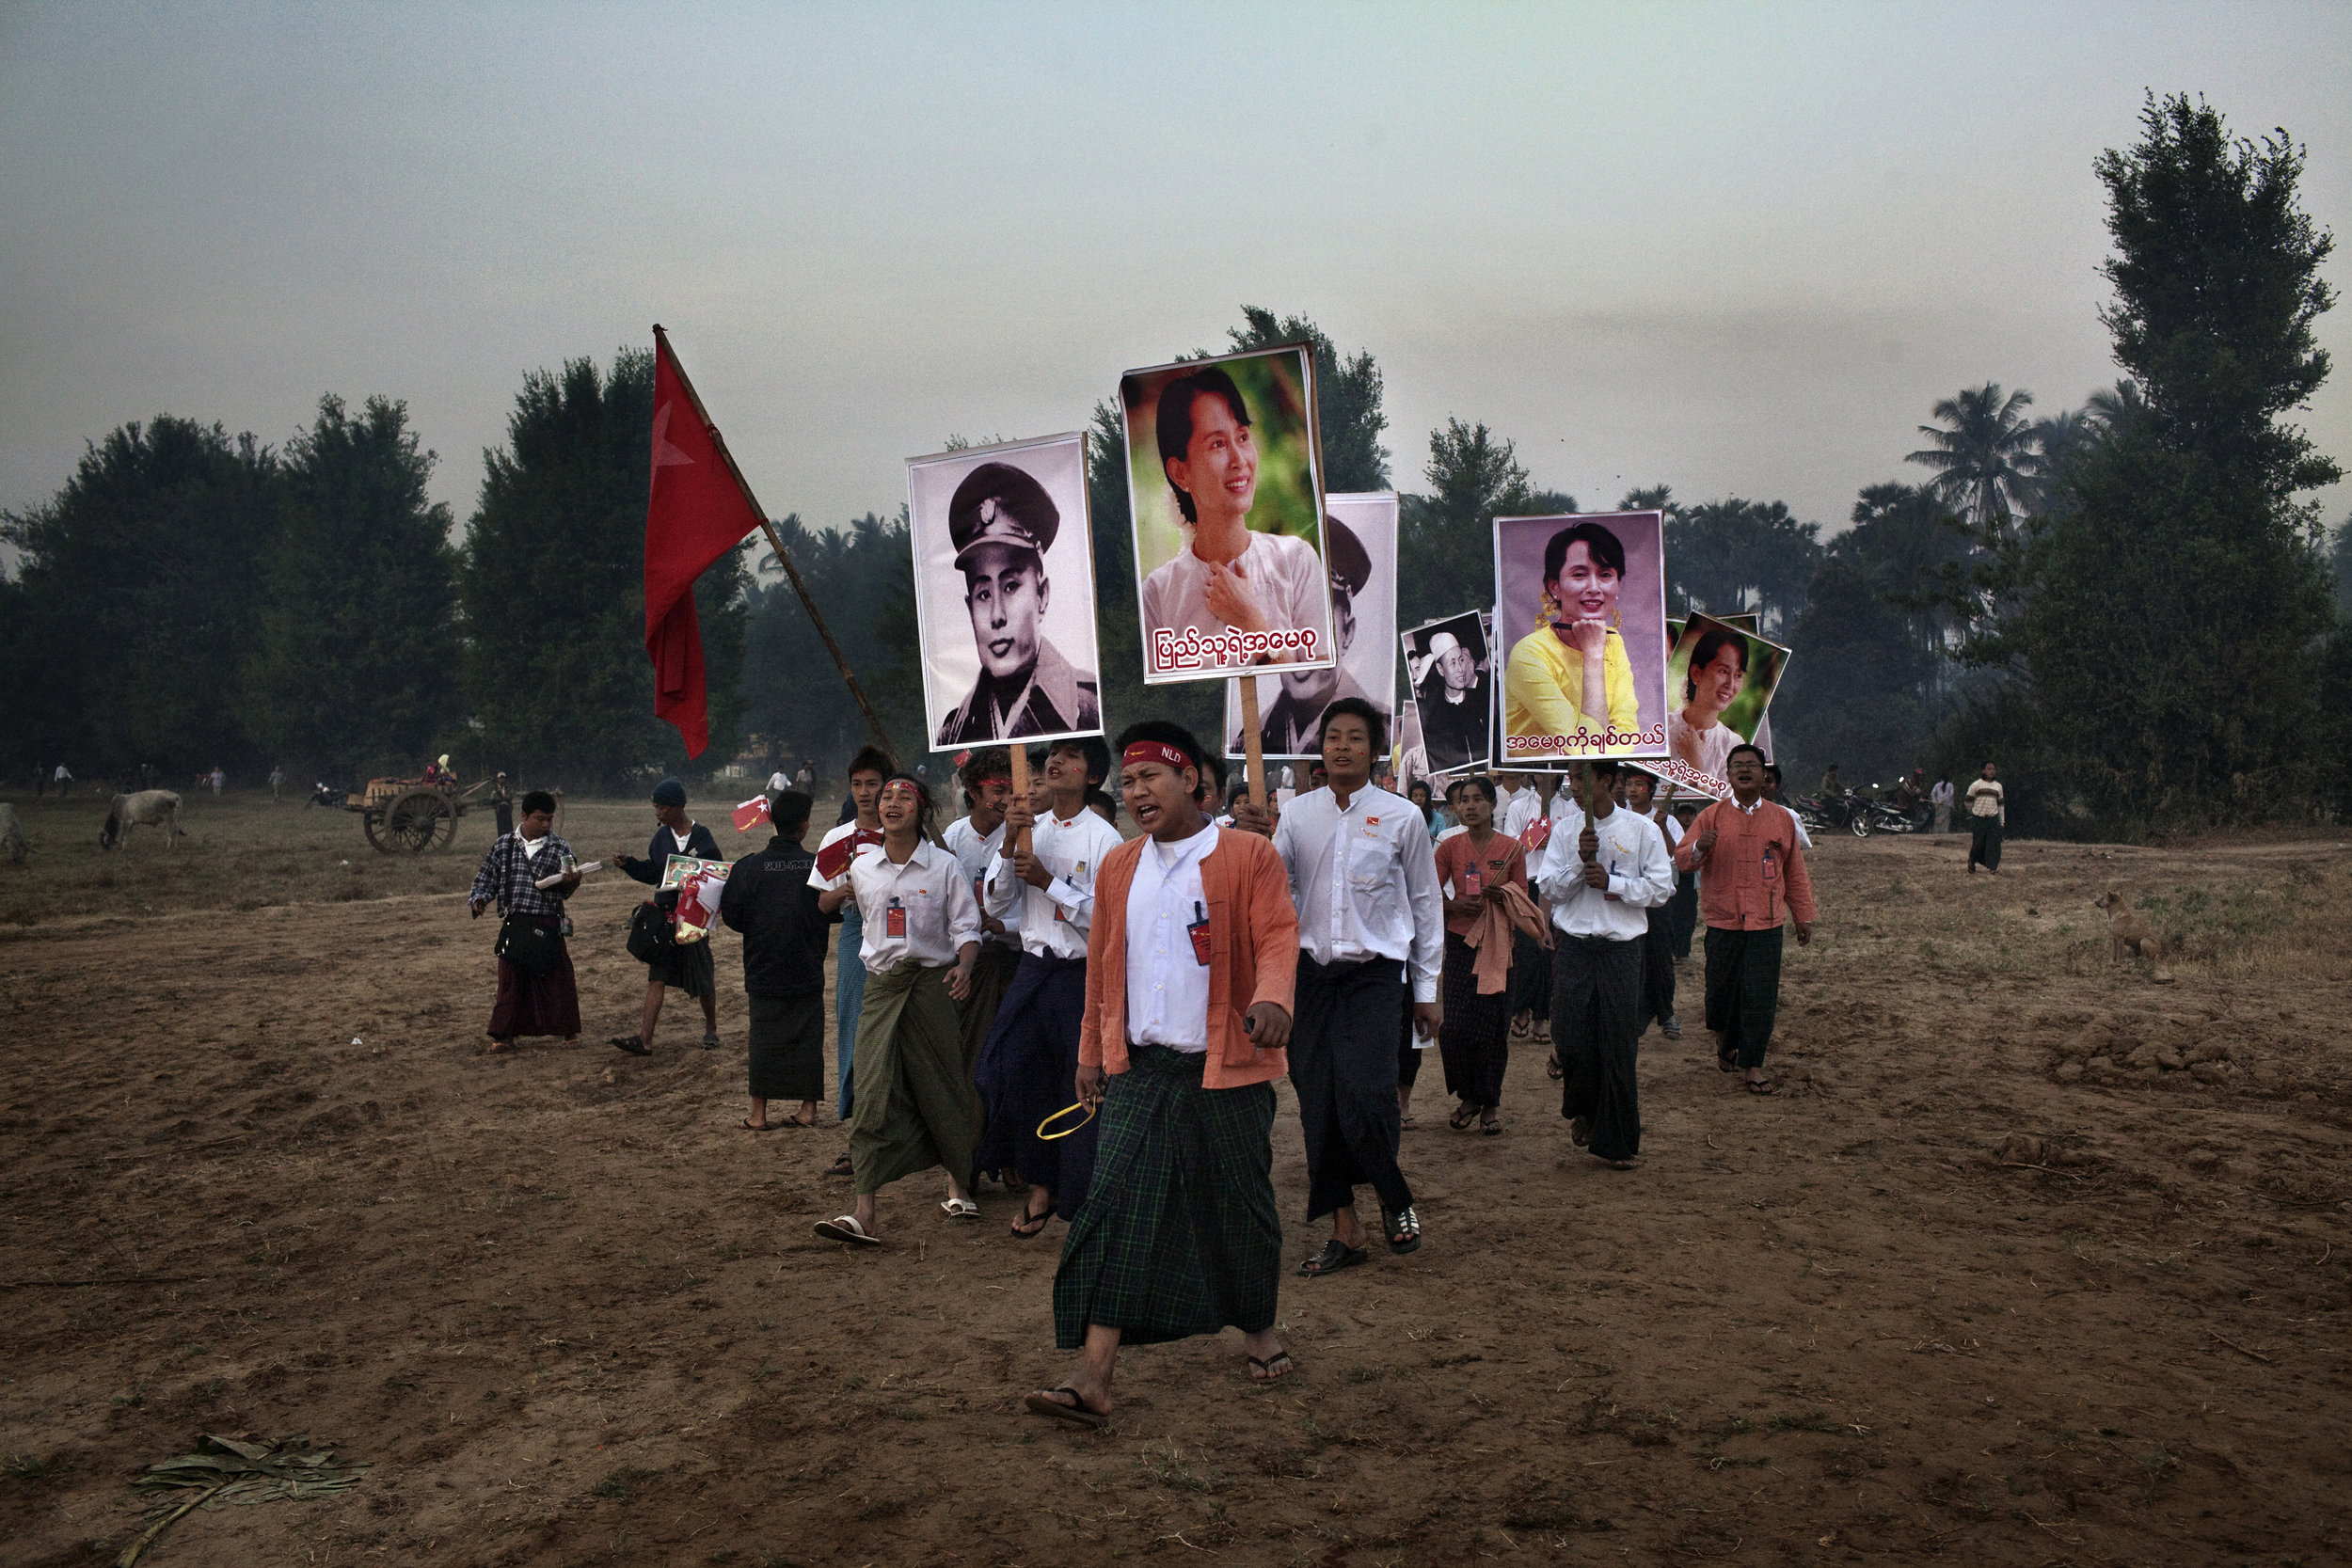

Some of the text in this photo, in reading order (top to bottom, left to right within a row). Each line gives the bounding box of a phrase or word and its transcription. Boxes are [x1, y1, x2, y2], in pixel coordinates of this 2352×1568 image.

[1154, 626, 1317, 670] ပြည်သူ့ရဲ့အမေစု
[1162, 746, 1182, 763] NLD
[1506, 723, 1665, 755] အမေစုကိုချစ်တယ်
